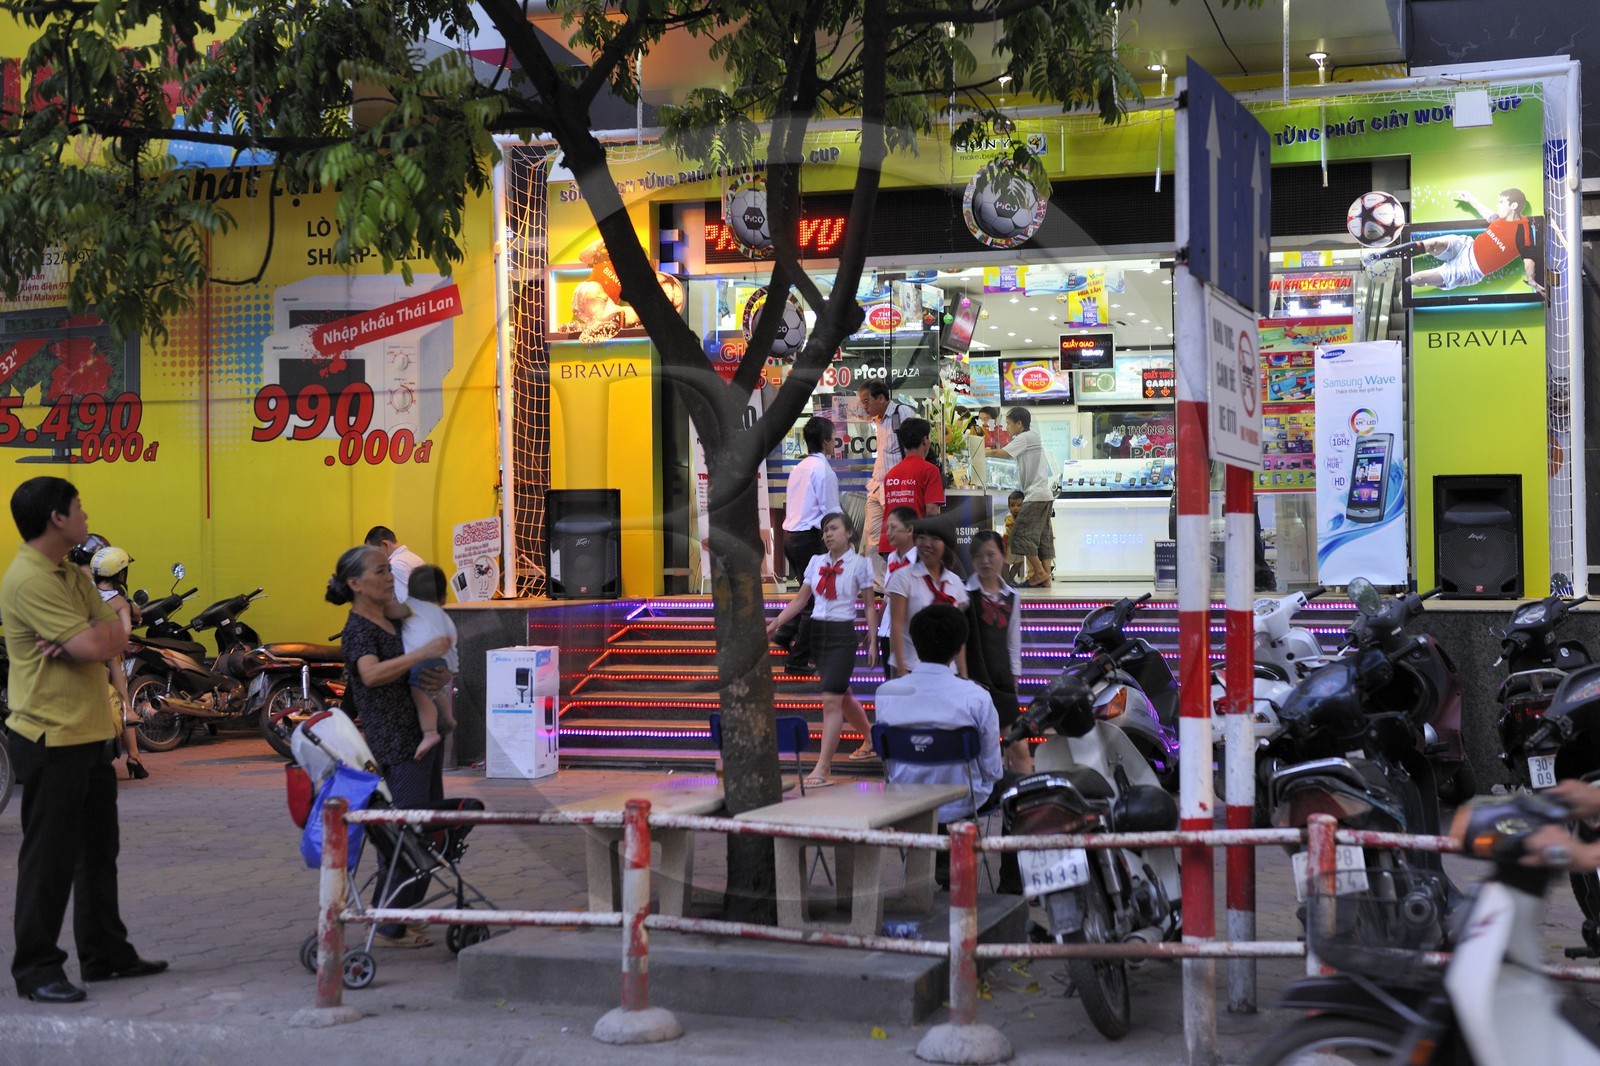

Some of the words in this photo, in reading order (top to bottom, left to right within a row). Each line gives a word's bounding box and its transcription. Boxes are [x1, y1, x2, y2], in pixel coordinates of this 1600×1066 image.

[1274, 122, 1321, 146] TỪNG
[1325, 115, 1365, 139] PHÚT
[1371, 109, 1409, 131] GIÂY
[1414, 104, 1454, 125] WOR
[810, 146, 841, 165] CUP
[307, 216, 331, 238] LÒ
[798, 218, 845, 251] VỤ
[1485, 229, 1506, 252] BRAVIA
[603, 266, 622, 287] BRAV
[59, 281, 70, 290] 97
[35, 292, 67, 302] Malaysia
[322, 328, 359, 346] Nhập
[360, 312, 395, 335] khẩu
[396, 303, 426, 324] Thái
[428, 296, 455, 315] Lan
[1428, 329, 1528, 349] BRAVIA
[561, 362, 638, 379] BRAVIA
[891, 367, 920, 378] PLAZA
[1145, 379, 1177, 388] CASHI
[1323, 377, 1363, 388] Samsung
[1364, 374, 1396, 386] Wave
[0, 391, 143, 443] 5.490
[252, 382, 375, 442] 990
[1128, 422, 1165, 436] THỐNG
[1333, 438, 1350, 446] 1GHz
[1334, 477, 1345, 486] HD
[956, 536, 973, 545] mob
[1086, 534, 1144, 545] SAMSUNG
